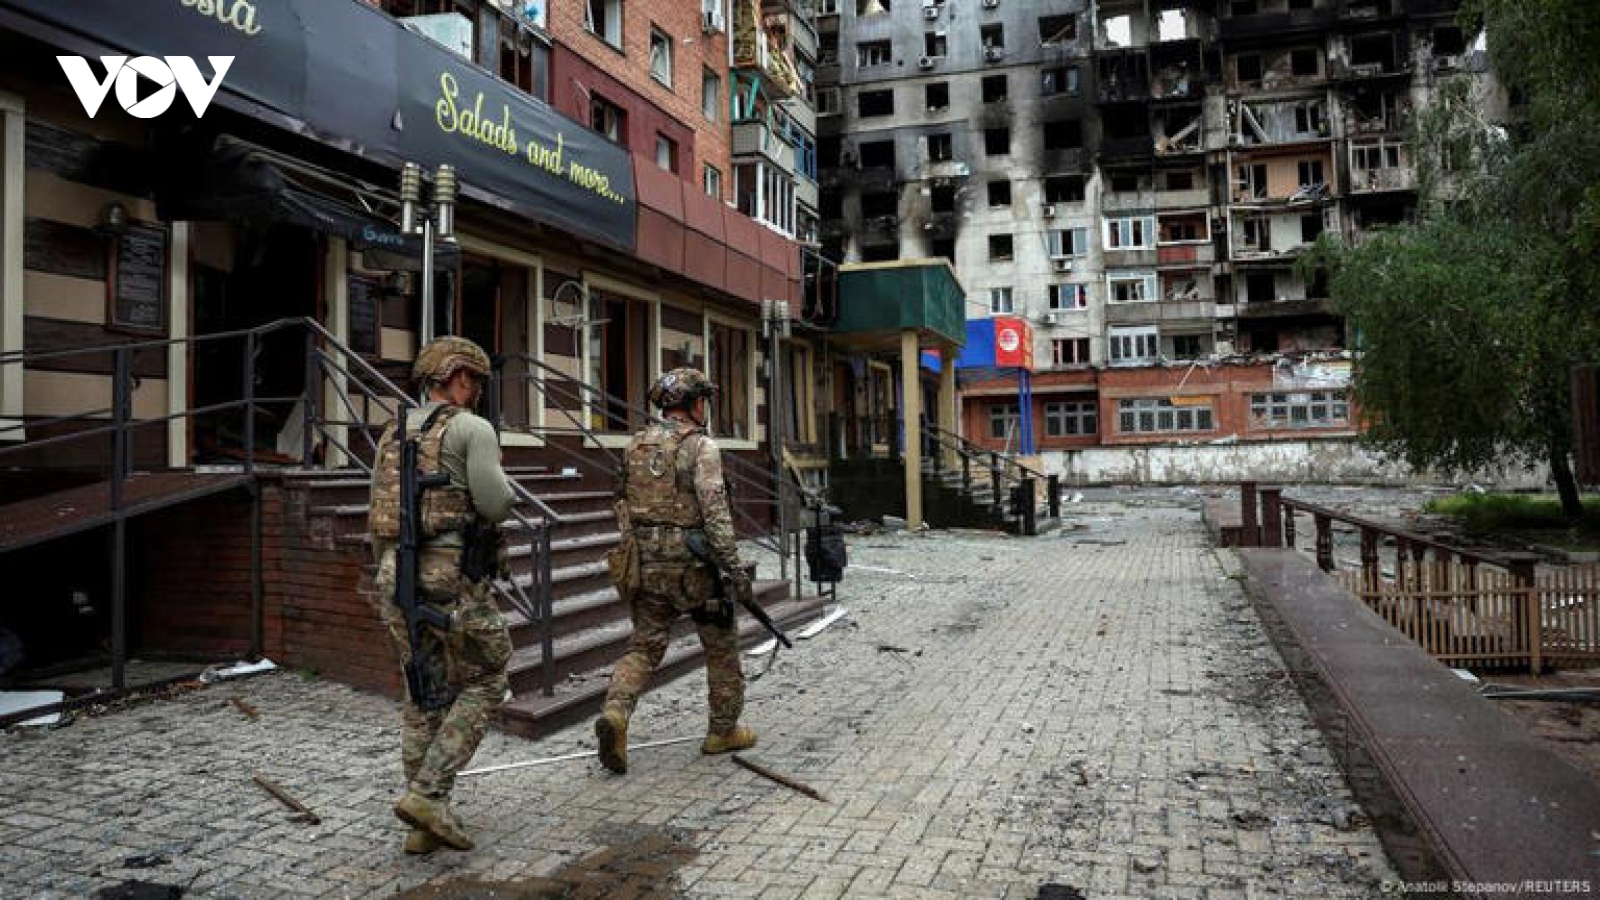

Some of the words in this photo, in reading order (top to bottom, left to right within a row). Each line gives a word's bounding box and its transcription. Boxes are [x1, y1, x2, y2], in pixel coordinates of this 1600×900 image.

[435, 72, 518, 155] Salads
[526, 132, 565, 175] and
[569, 160, 625, 205] more...
